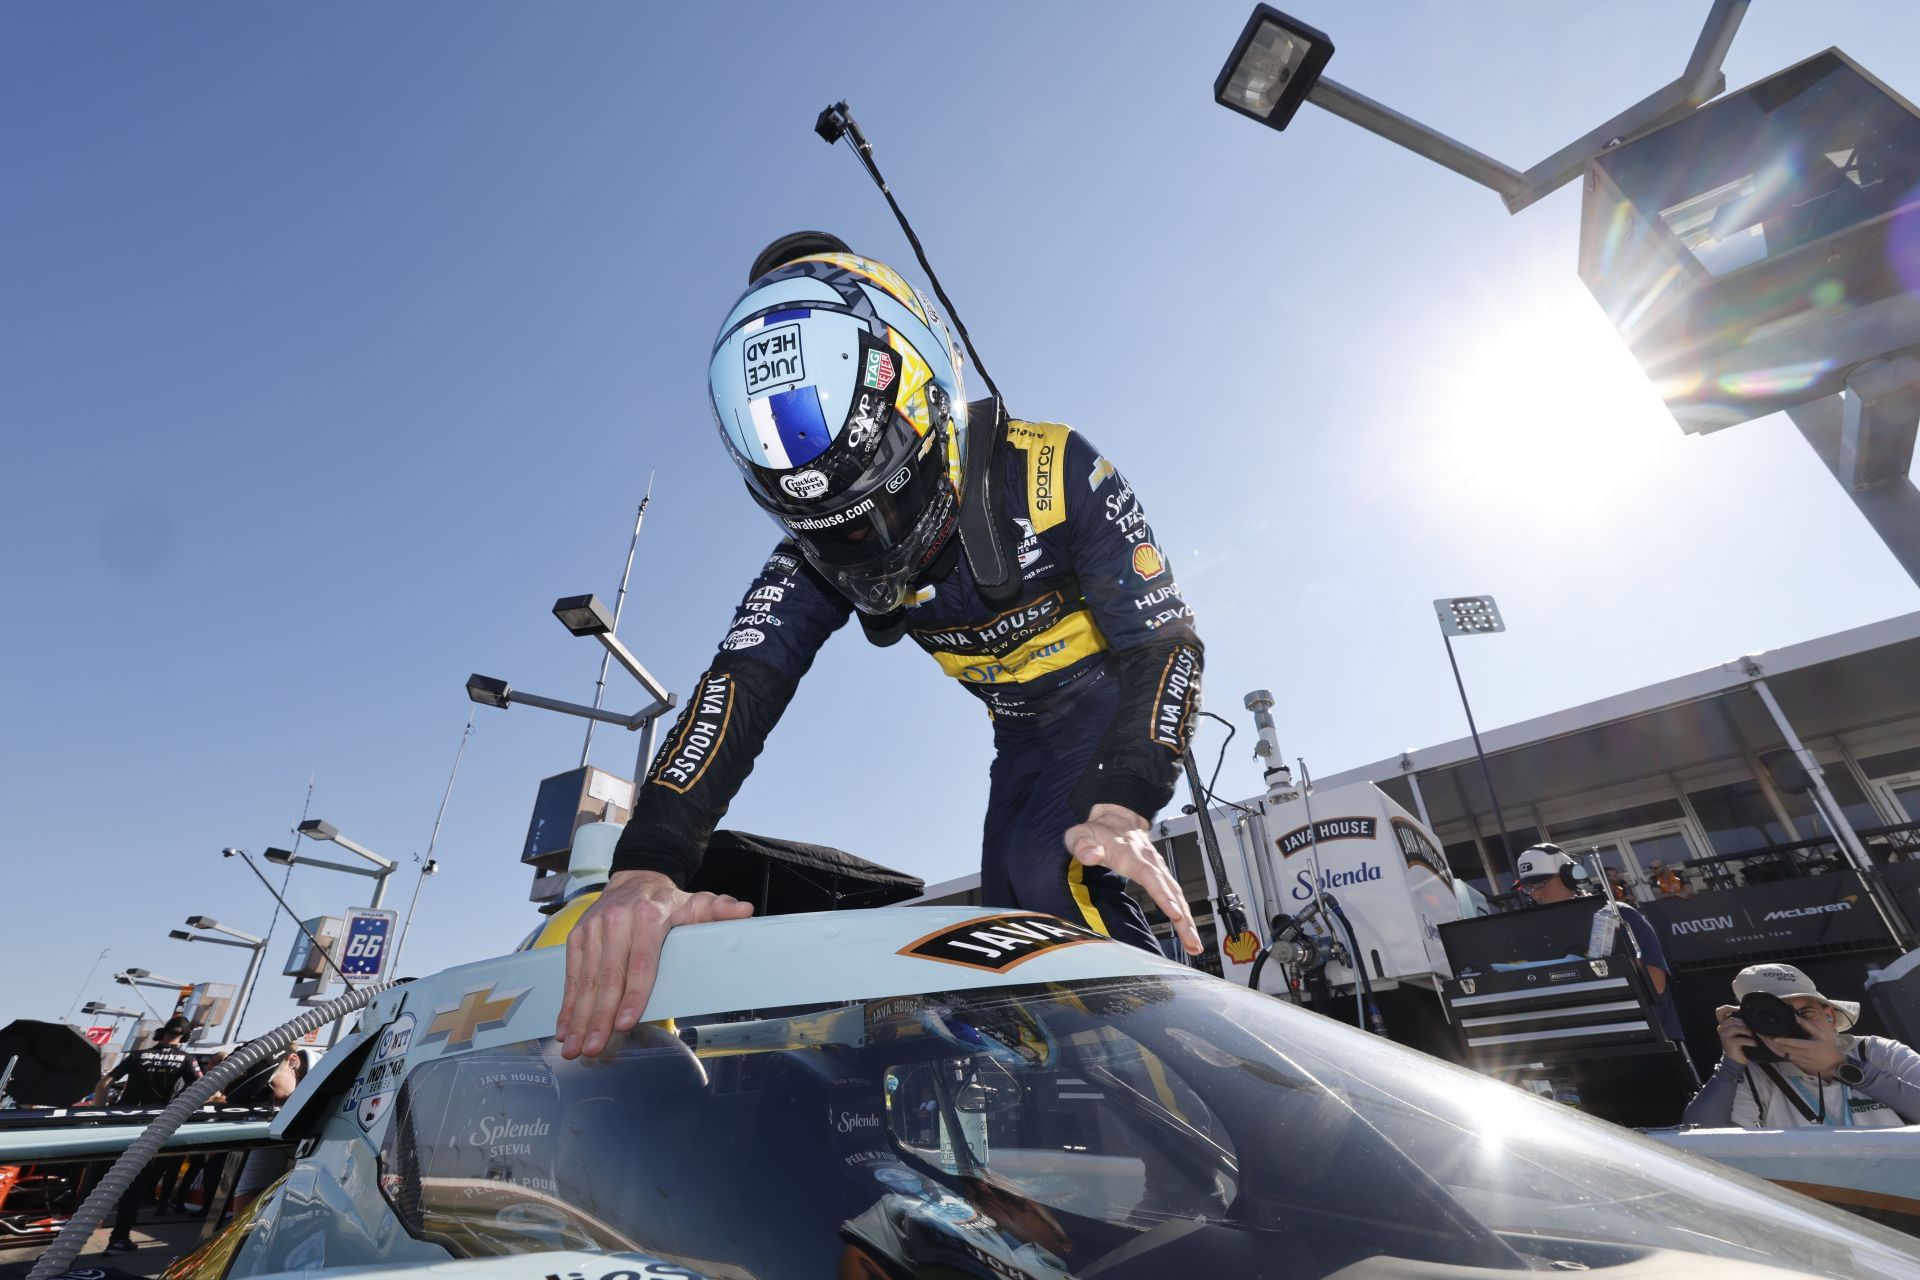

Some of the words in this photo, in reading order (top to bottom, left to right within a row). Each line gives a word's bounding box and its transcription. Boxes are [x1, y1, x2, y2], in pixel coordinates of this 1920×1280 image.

[746, 332, 797, 361] HEAD
[748, 355, 798, 386] JUICE
[866, 352, 880, 384] TAG
[878, 353, 894, 388] HEUER
[785, 476, 819, 492] Cracker
[795, 480, 825, 498] Barrel
[890, 472, 909, 489] ecr
[1036, 445, 1056, 512] sparco
[783, 498, 875, 530] JavaHouse.com
[731, 612, 782, 628] URCO
[745, 602, 771, 611] TEA
[1167, 648, 1196, 701] HOUSE
[700, 677, 727, 714] JAVA
[1159, 704, 1182, 745] JAVA
[665, 721, 718, 783] HOUSE
[1283, 829, 1317, 852] JAVA
[1319, 820, 1370, 838] HOUSE
[1763, 902, 1852, 921] McLaren
[347, 934, 383, 957] 66
[947, 921, 1080, 959] JAVA
[480, 1073, 507, 1085] JAVA
[511, 1073, 549, 1084] HOUSE
[469, 1116, 550, 1146] Splenda
[838, 1112, 880, 1133] Splenda
[490, 1143, 531, 1158] STEVIA
[522, 1177, 557, 1191] POUR
